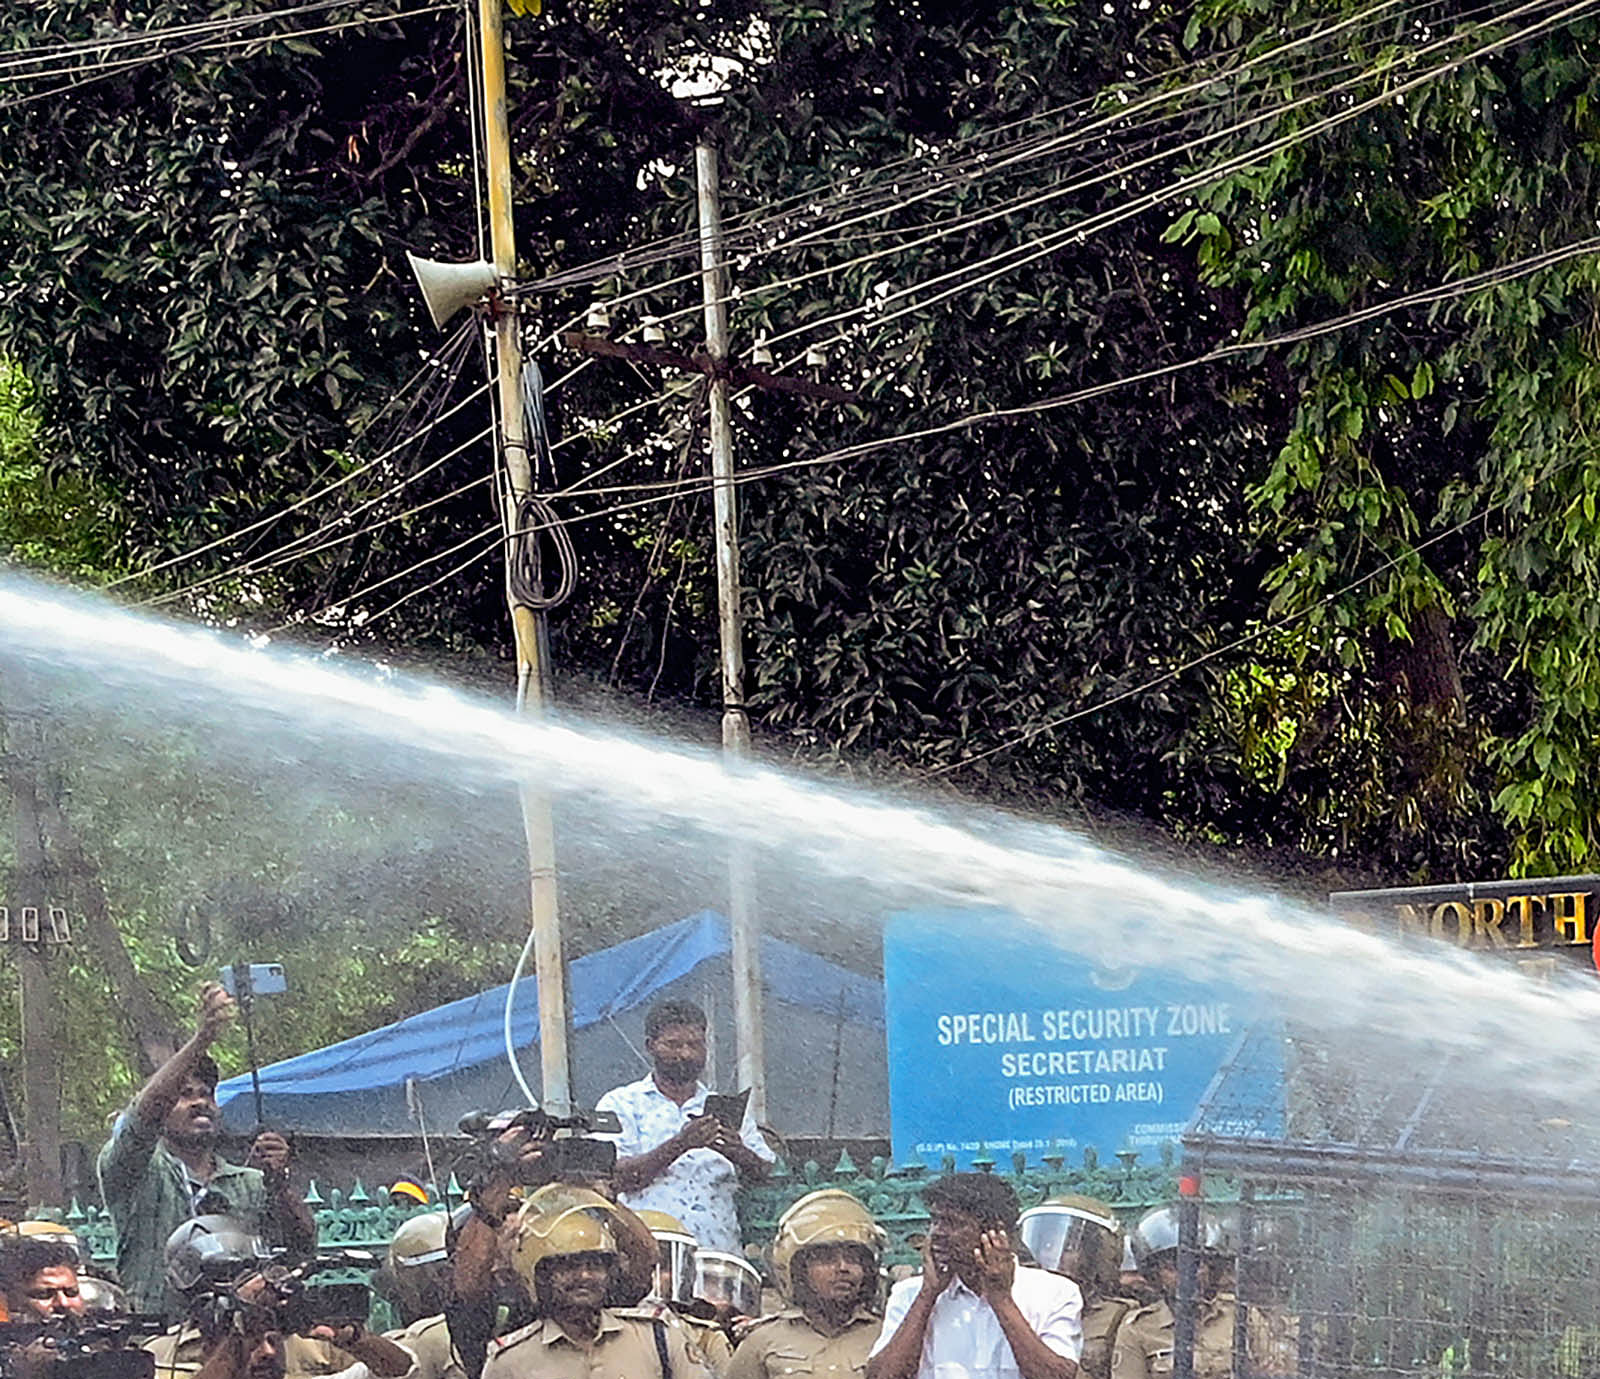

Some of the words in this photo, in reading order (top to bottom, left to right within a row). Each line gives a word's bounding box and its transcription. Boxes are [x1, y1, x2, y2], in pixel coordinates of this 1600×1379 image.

[1394, 891, 1593, 950] NORTH
[937, 1012, 1036, 1046] SPECIAL
[1043, 1006, 1160, 1041] SECURITY
[1166, 1003, 1232, 1036] ZONE
[1001, 1047, 1168, 1078] SECRETARIAT
[1008, 1083, 1111, 1110] (RESTRICTED
[1115, 1082, 1164, 1105] AREA)
